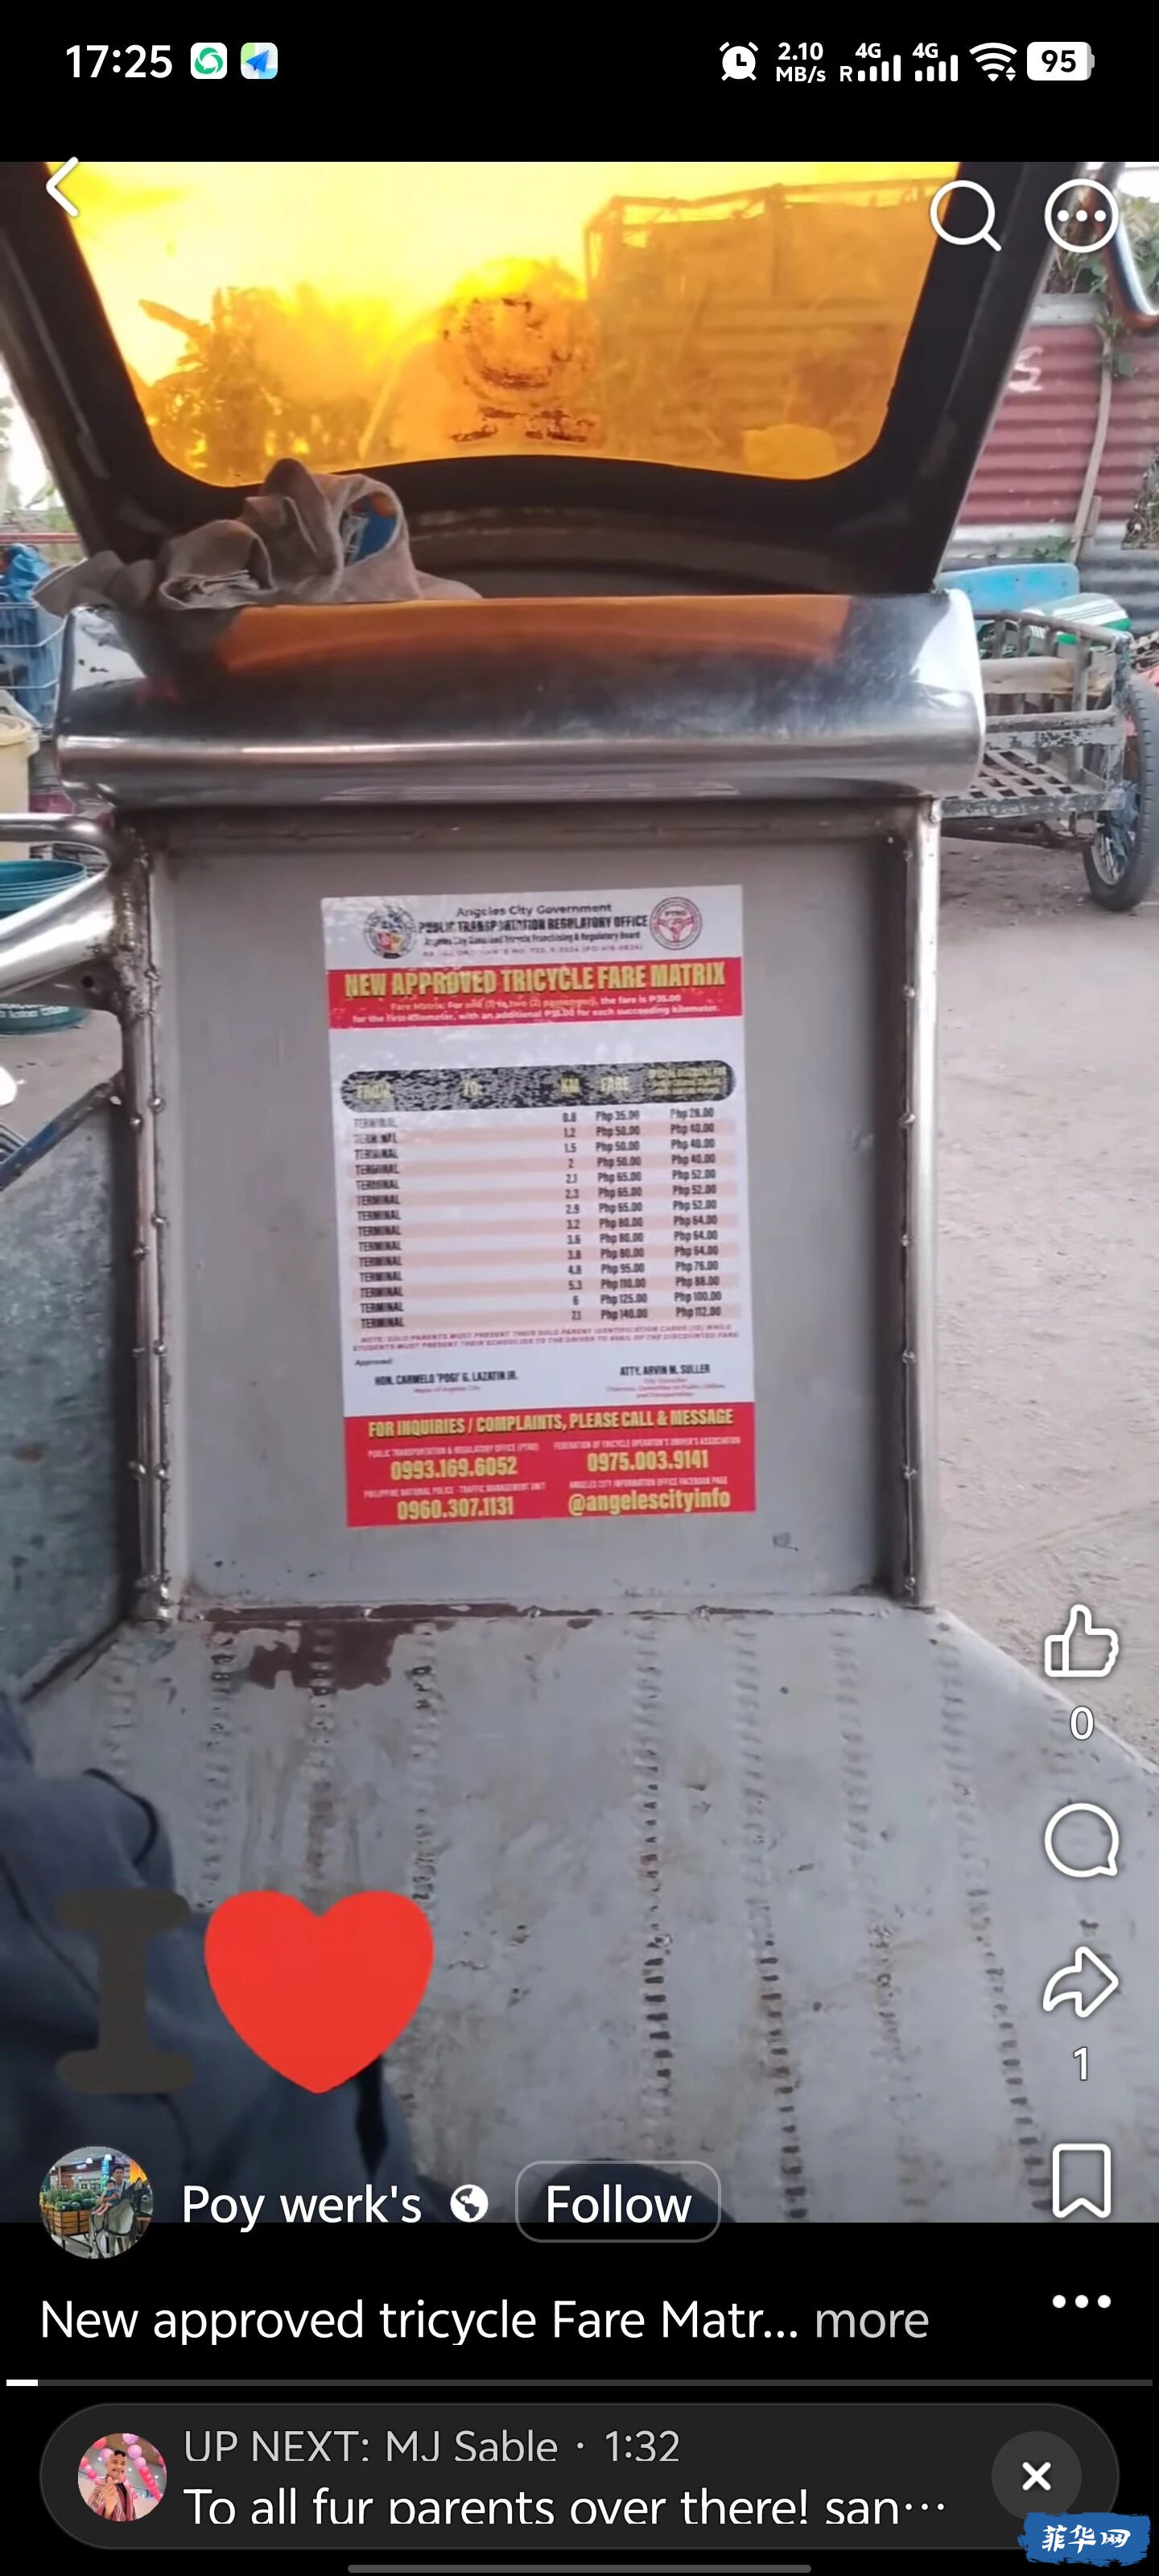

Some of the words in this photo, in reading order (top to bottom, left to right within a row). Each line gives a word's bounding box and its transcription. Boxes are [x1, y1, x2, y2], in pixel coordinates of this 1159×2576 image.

[508, 905, 532, 917] City
[537, 902, 612, 914] Government
[613, 914, 647, 927] OFFICE
[344, 972, 386, 997] NEW
[391, 969, 497, 996] APPROVED
[501, 966, 593, 993] TRICYCLE
[597, 964, 646, 989] FARE
[650, 962, 725, 988] MATRIX
[596, 1111, 613, 1123] Php
[614, 1110, 640, 1121] 35.00
[689, 1108, 714, 1118] 28.00
[563, 1128, 575, 1137] 1.2
[596, 1126, 614, 1138] Php
[615, 1125, 640, 1136] 50.00
[670, 1124, 687, 1136] Php
[690, 1123, 714, 1133] 40.00
[564, 1143, 576, 1153] 1.5
[596, 1141, 613, 1154] Php
[615, 1141, 639, 1151] 50.00
[670, 1139, 688, 1151] Php
[690, 1138, 715, 1149] 40.00
[355, 1164, 398, 1175] TERMINAL
[568, 1158, 574, 1168] 2
[597, 1158, 615, 1170] Php
[616, 1156, 641, 1166] 50.00
[671, 1154, 688, 1166] Php
[691, 1154, 716, 1164] 40.00
[356, 1179, 399, 1191] TERMINAL
[565, 1174, 577, 1183] 2.1
[597, 1173, 615, 1185] Php
[617, 1171, 641, 1182] 65.00
[672, 1170, 689, 1182] Php
[691, 1169, 716, 1179] 52.00
[357, 1195, 400, 1206] TERMINAL
[565, 1189, 579, 1199] 2.3
[598, 1188, 616, 1200] Php
[617, 1187, 641, 1197] 65.00
[672, 1185, 690, 1197] Php
[692, 1184, 716, 1195] 52.00
[357, 1210, 400, 1221] TERMINAL
[566, 1204, 580, 1214] 2.9
[599, 1203, 616, 1216] Php
[617, 1202, 642, 1212] 65.00
[673, 1200, 690, 1212] Php
[692, 1199, 716, 1210] 52.00
[357, 1225, 401, 1236] TERMINAL
[566, 1220, 580, 1229] 3.2
[599, 1219, 617, 1230] Php
[618, 1217, 643, 1228] 80.00
[673, 1216, 690, 1228] Php
[692, 1215, 717, 1225] 64.00
[358, 1241, 402, 1252] TERMINAL
[567, 1235, 580, 1245] 3.6
[600, 1234, 617, 1245] Php
[618, 1232, 644, 1243] 80.00
[674, 1231, 691, 1243] Php
[693, 1230, 717, 1241] 64.00
[359, 1256, 402, 1267] TERMINAL
[567, 1250, 581, 1260] 3.8
[600, 1249, 617, 1261] Php
[619, 1248, 644, 1258] 80.00
[674, 1246, 691, 1258] Php
[693, 1245, 718, 1256] 64.00
[360, 1271, 402, 1282] TERMINAL
[567, 1265, 582, 1275] 4.8
[601, 1264, 618, 1276] Php
[620, 1263, 645, 1274] 95.00
[675, 1261, 691, 1274] Php
[694, 1261, 718, 1270] 76.00
[360, 1286, 403, 1298] TERMINAL
[568, 1281, 582, 1290] 5.3
[600, 1279, 618, 1291] Php
[620, 1278, 645, 1288] 110.00
[675, 1277, 692, 1289] Php
[695, 1276, 719, 1286] 88.00
[361, 1302, 404, 1313] TERMINAL
[572, 1296, 578, 1305] 6
[600, 1294, 617, 1307] Php
[619, 1294, 647, 1303] 125.00
[674, 1292, 691, 1304] Php
[693, 1291, 721, 1301] 100.00
[361, 1317, 405, 1328] TERMINAL
[601, 1310, 617, 1322] Php
[620, 1309, 647, 1319] 140.00
[675, 1307, 693, 1319] Php
[695, 1306, 721, 1316] 112.00
[374, 1375, 394, 1385] HON.
[396, 1373, 434, 1385] CARMELO
[462, 1373, 471, 1382] G.
[472, 1371, 505, 1381] LAZATIN
[620, 1366, 641, 1377] ATTY.
[643, 1365, 666, 1375] ARVIN
[669, 1365, 678, 1374] M.
[680, 1364, 710, 1374] SULLER
[369, 1421, 394, 1437] FOR
[397, 1418, 464, 1437] INQUIRIES
[468, 1418, 472, 1432] /
[476, 1414, 566, 1434] COMPLAINTS,
[569, 1412, 619, 1430] PLEASE
[621, 1410, 654, 1428] CALL
[657, 1410, 667, 1426] &
[670, 1408, 733, 1426] MESSAGE
[390, 1456, 518, 1480] 0993.169.6052
[587, 1448, 708, 1472] 0975.003.9141
[397, 1496, 514, 1520] 0960.307.1131
[567, 1487, 731, 1516] @angelescityinfo
